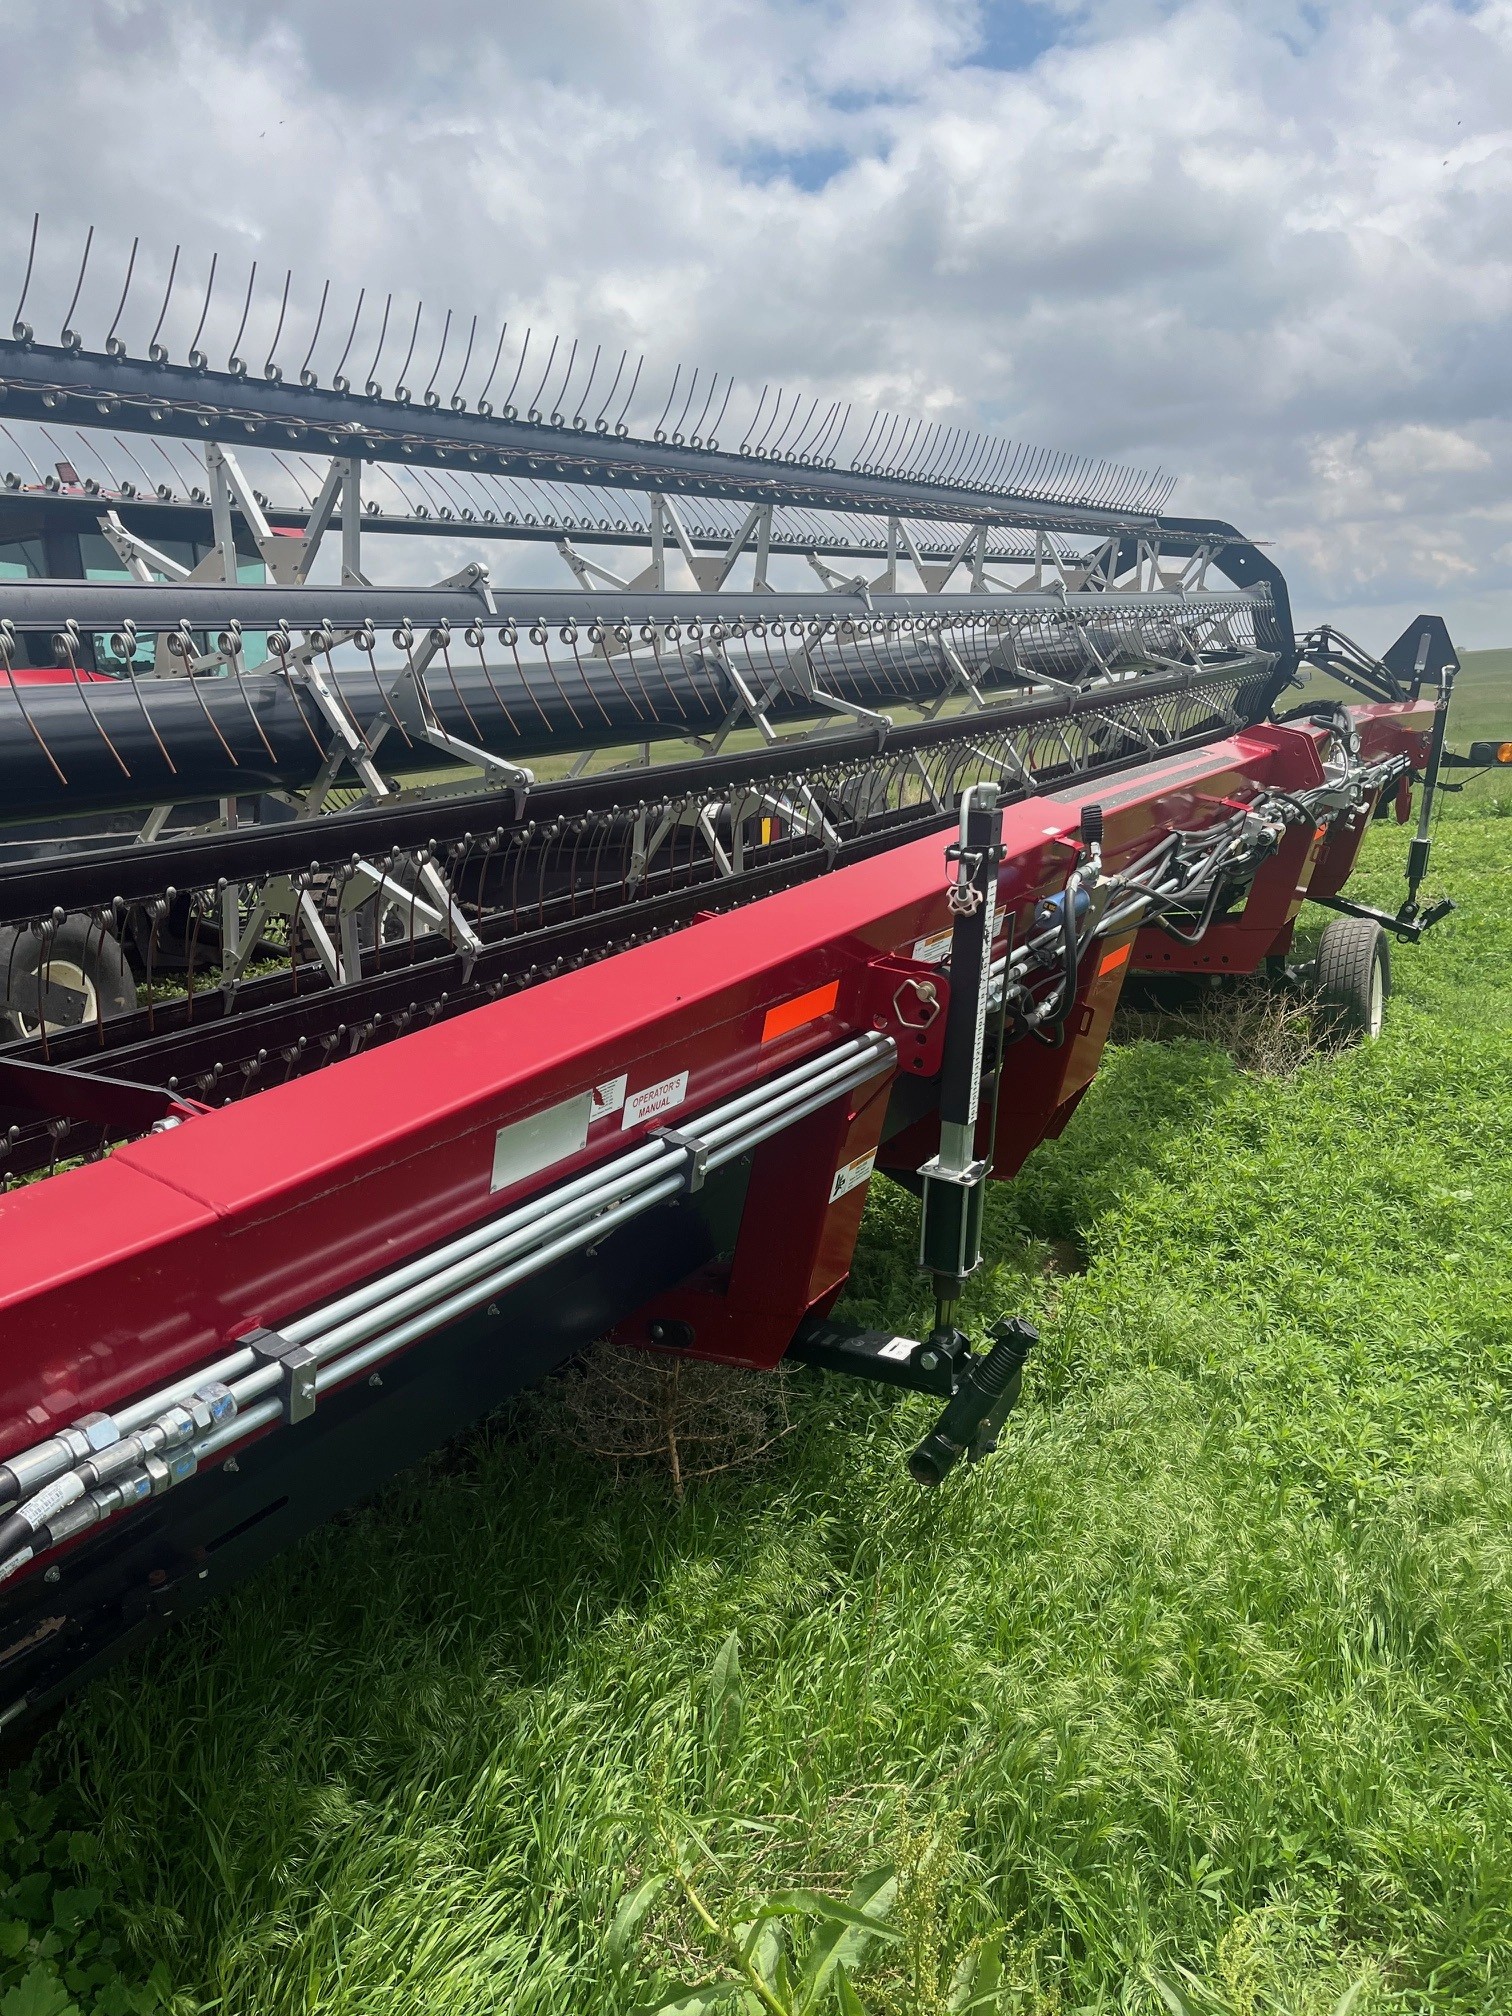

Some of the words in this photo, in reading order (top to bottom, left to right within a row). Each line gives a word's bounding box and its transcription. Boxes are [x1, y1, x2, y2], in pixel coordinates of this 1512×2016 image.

[977, 1021, 983, 1031] 10
[975, 1051, 980, 1061] 12
[973, 1080, 978, 1091] 14
[632, 1078, 681, 1108] OPERATOR'S
[638, 1096, 671, 1118] MANUAL
